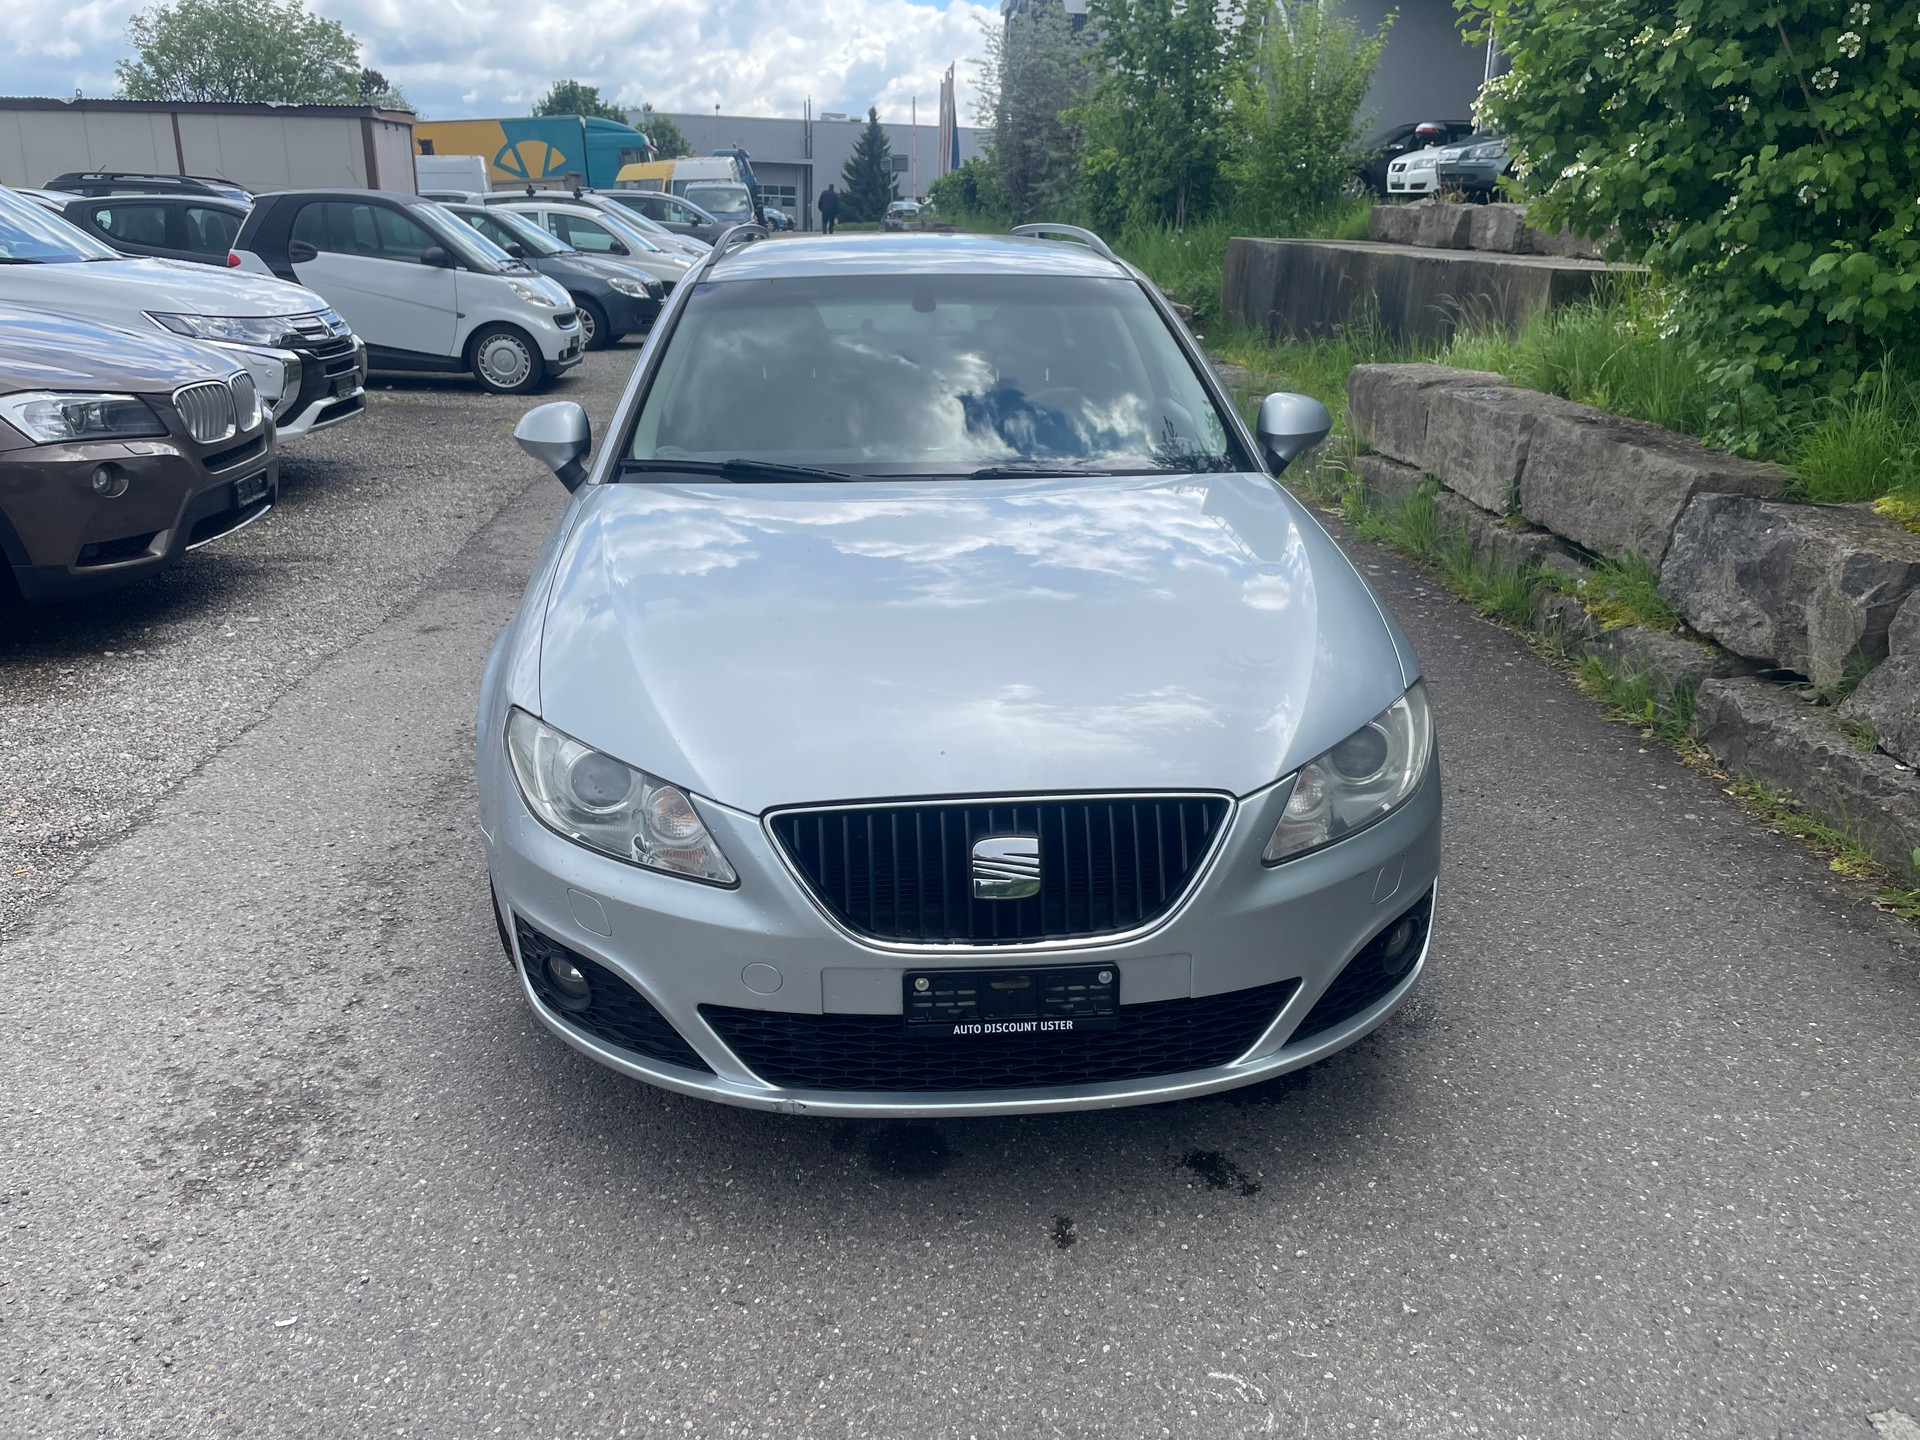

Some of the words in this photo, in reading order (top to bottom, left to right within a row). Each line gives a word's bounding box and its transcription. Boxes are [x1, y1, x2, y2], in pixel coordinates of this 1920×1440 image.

[953, 1024, 982, 1035] AUTO
[984, 1021, 1038, 1034] DISCOUNT
[1040, 1020, 1074, 1031] USTER
